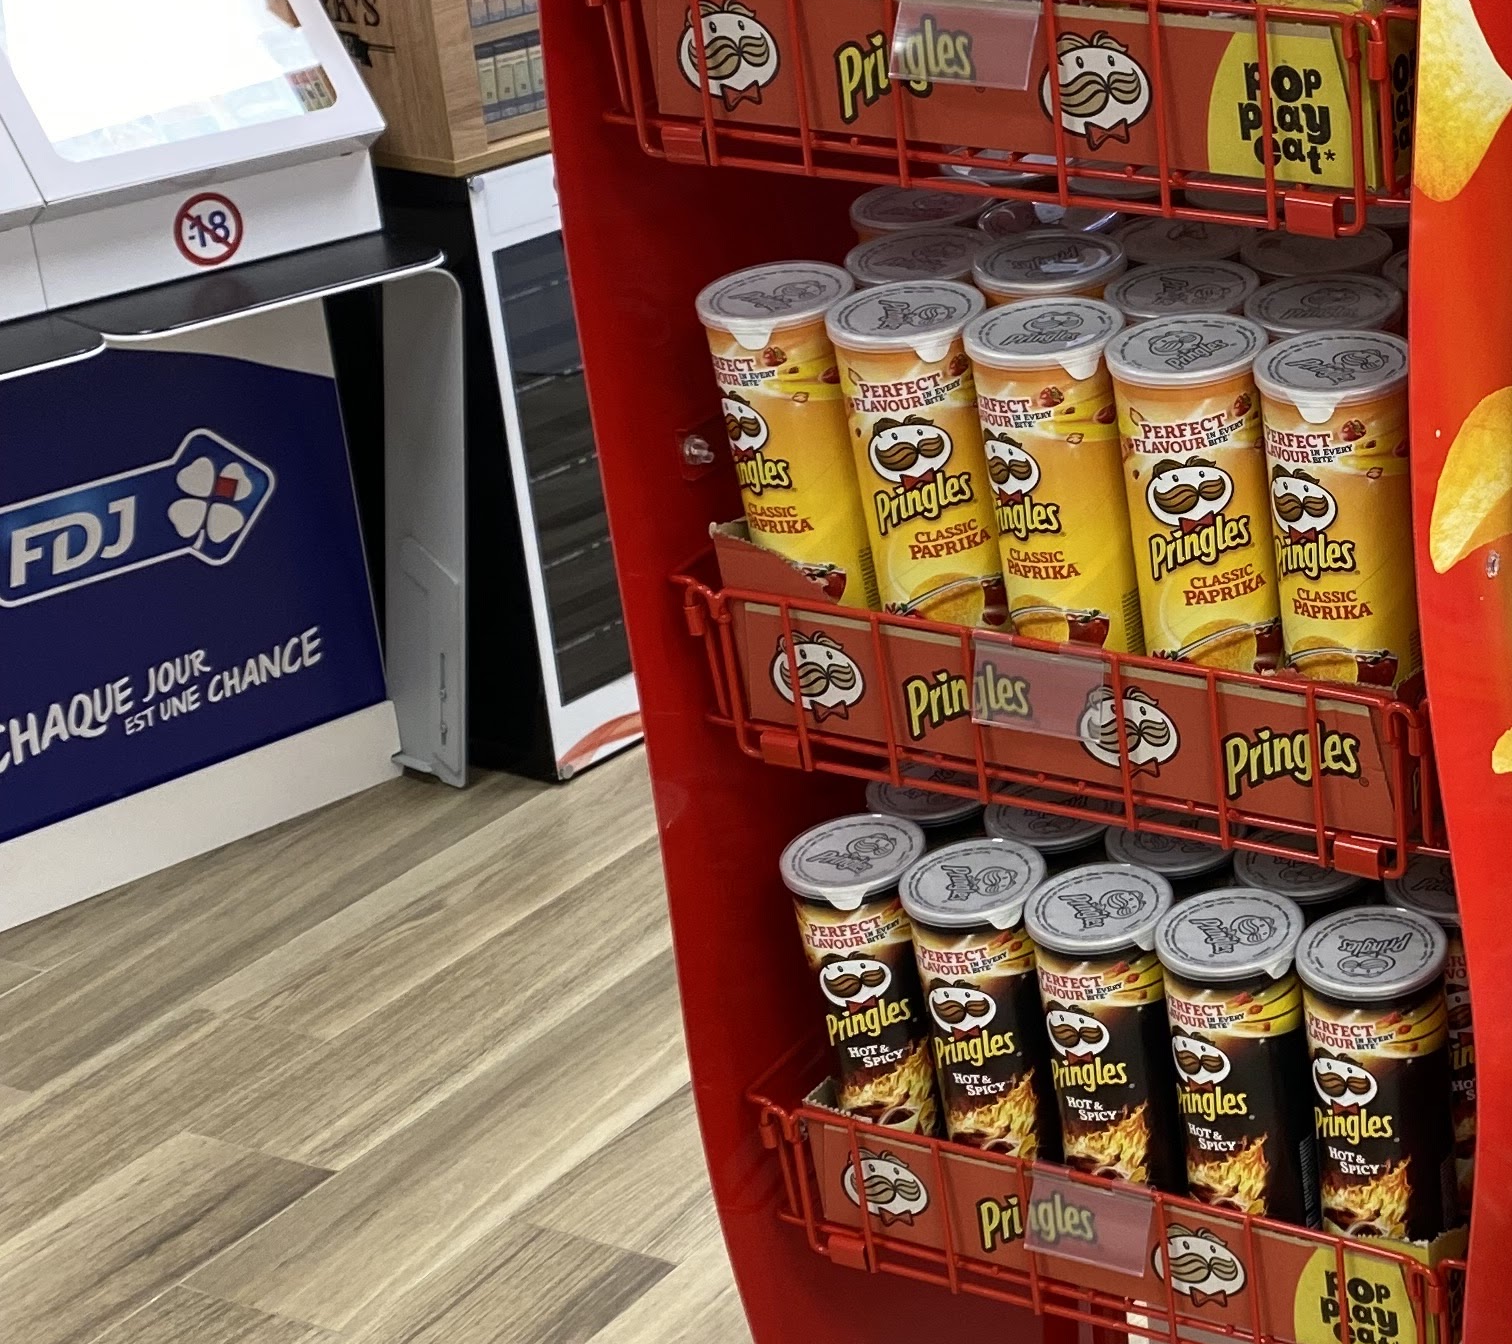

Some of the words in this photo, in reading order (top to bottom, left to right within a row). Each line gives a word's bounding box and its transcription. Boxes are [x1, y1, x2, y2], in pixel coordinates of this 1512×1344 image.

[838, 17, 972, 124] Prigles
[1237, 97, 1332, 145] pay
[1140, 414, 1229, 441] PERFECT
[1217, 419, 1245, 437] EVERY
[876, 471, 972, 536] Pringles
[9, 495, 137, 589] FDJ
[908, 528, 992, 560] PAPRIKA
[915, 518, 978, 544] CLASSIC
[1008, 547, 1064, 565] CLASSIC
[1151, 515, 1250, 580] Pringles
[1006, 558, 1081, 582] PAPRIKA
[1190, 564, 1254, 590] CLASSIC
[1184, 574, 1267, 607] PAPRIKA
[1296, 587, 1357, 604] CLASSIC
[1291, 599, 1374, 621] PAPRIKA
[124, 708, 157, 736] EST
[160, 689, 201, 725] UNE
[207, 627, 323, 705] CHANCE
[143, 648, 212, 703] JOUR
[1224, 727, 1358, 796] Pringes
[826, 997, 912, 1046] Pringles
[848, 1045, 877, 1058] HOT
[863, 1049, 904, 1069] SPICY
[934, 1030, 1015, 1069] Pringles
[953, 1072, 980, 1085] HOT
[1051, 1056, 1127, 1094] Pringles
[966, 1081, 1006, 1097] SPICY
[1066, 1096, 1092, 1110] HOT
[1079, 1108, 1118, 1123] SPICY
[1188, 1122, 1212, 1139] HOT
[1314, 1107, 1393, 1146] Pringles
[1198, 1137, 1236, 1152] SPICY
[1329, 1147, 1355, 1163] HOT
[1341, 1162, 1380, 1176] SPICY
[1318, 1296, 1400, 1338] pay
